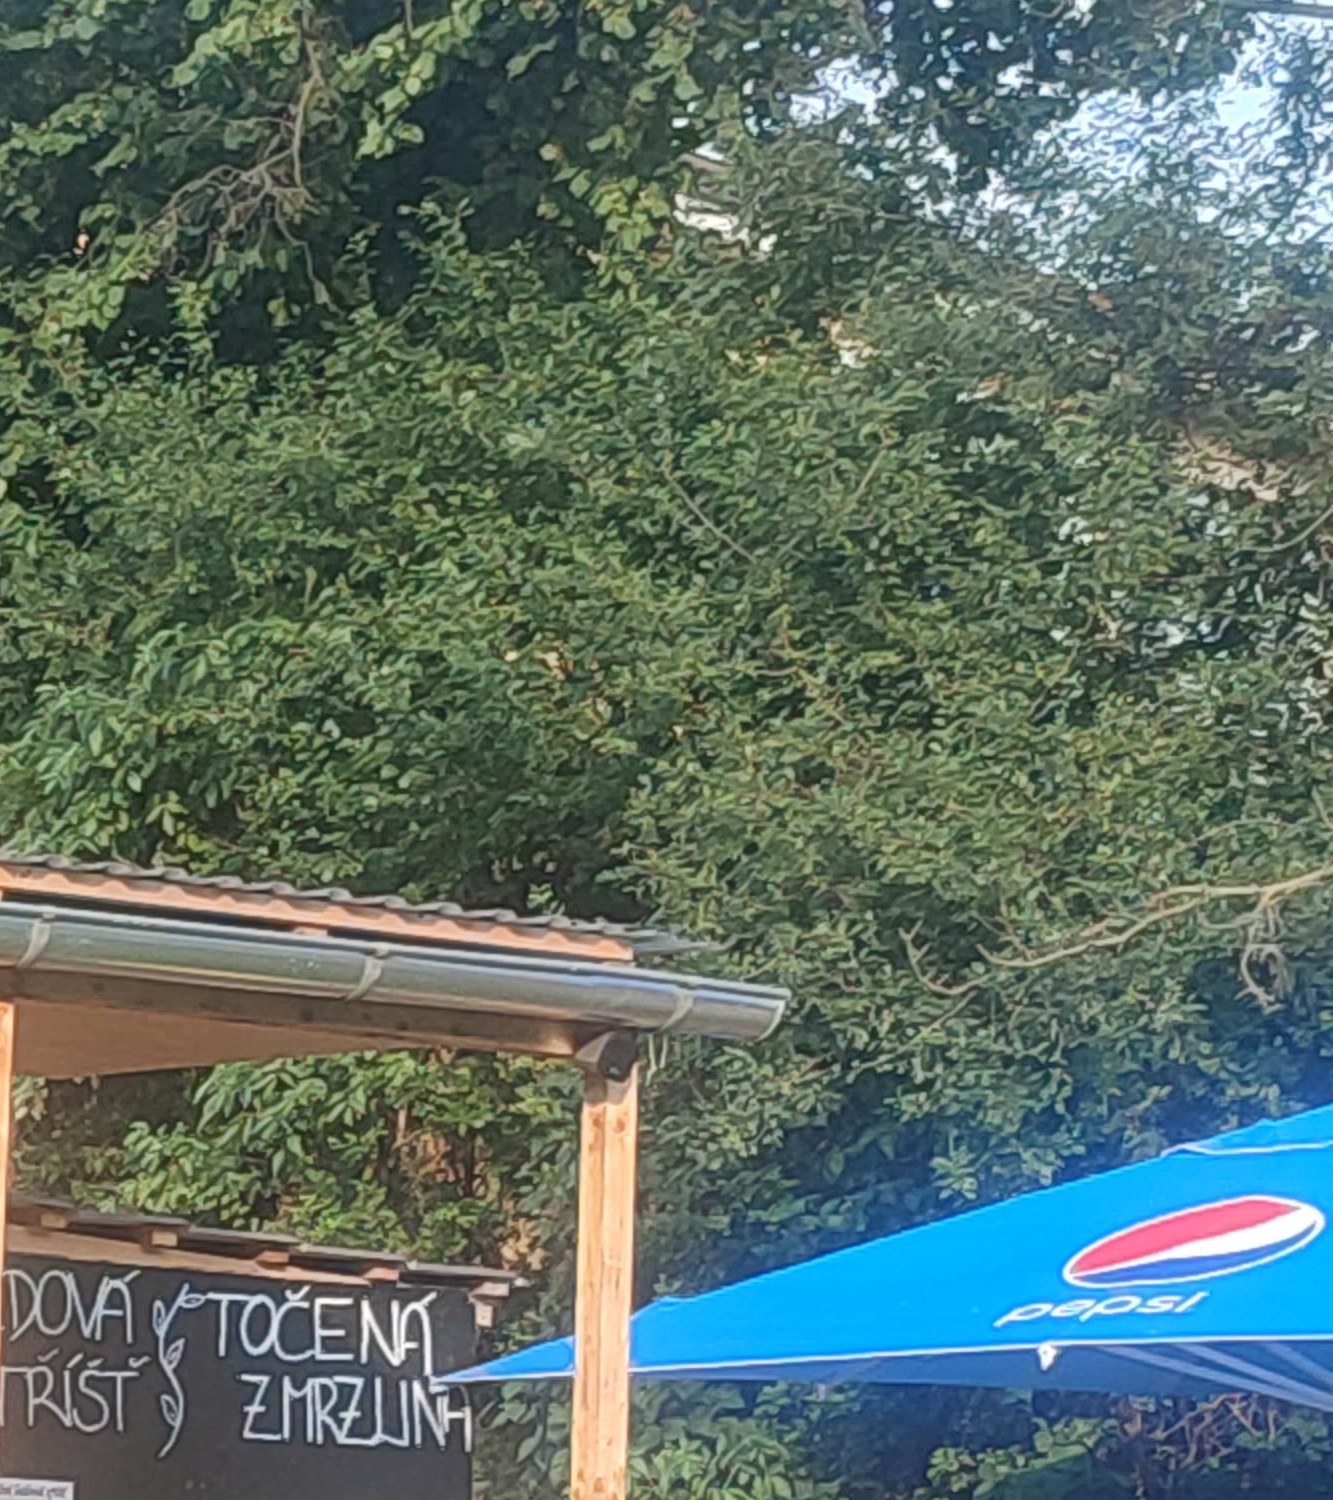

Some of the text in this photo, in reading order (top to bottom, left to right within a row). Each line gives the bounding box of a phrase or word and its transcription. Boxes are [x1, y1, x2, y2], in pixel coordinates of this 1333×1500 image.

[1, 1268, 438, 1377] DOVÁ TOČENÁ
[992, 1290, 1211, 1328] pepsi
[236, 1372, 472, 1453] ZMRZLINA
